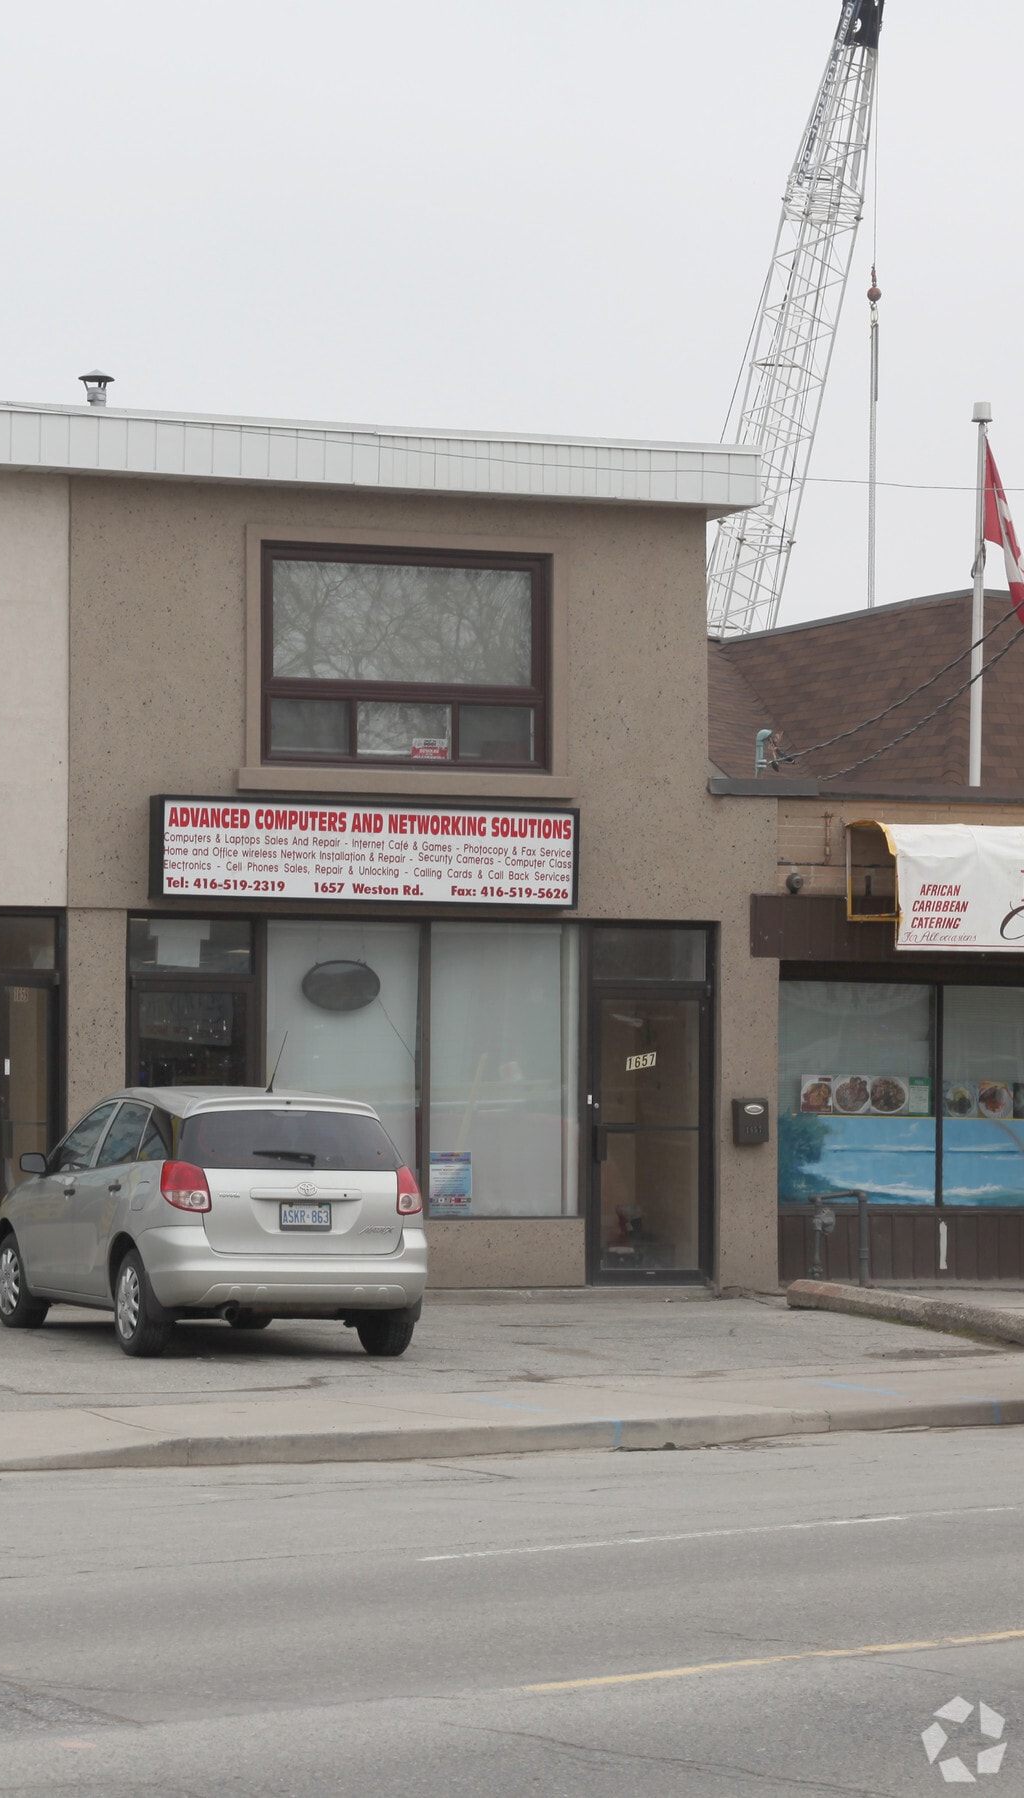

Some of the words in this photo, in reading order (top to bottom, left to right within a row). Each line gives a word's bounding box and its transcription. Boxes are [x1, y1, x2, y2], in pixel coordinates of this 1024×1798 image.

[168, 807, 250, 829] ADVANCED
[255, 808, 347, 833] COMPUTERS
[351, 812, 384, 834] AND
[388, 813, 487, 838] NETWORKING
[491, 816, 572, 840] SOLUTIONS
[164, 832, 212, 846] Computers
[215, 834, 221, 844] &
[224, 834, 261, 847] Laptops
[264, 835, 289, 846] Sales
[292, 836, 309, 847] And
[312, 837, 341, 849] Repair
[351, 838, 384, 850] Internet
[412, 841, 418, 851] &
[421, 842, 452, 853] Games
[463, 843, 509, 857] Photocopy
[512, 846, 517, 856] &
[521, 846, 536, 857] Fax
[540, 847, 572, 859] Service
[164, 846, 189, 856] Home
[192, 847, 209, 857] and
[212, 847, 239, 858] Office
[242, 847, 278, 859] wireless
[280, 849, 316, 861] Network
[319, 850, 366, 863] Installation
[369, 852, 375, 862] &
[378, 853, 406, 865] Repair
[418, 852, 453, 865] Security
[456, 854, 494, 866] Cameras
[504, 856, 546, 869] Computer
[548, 858, 572, 869] Class
[163, 859, 212, 871] Electronics
[225, 861, 243, 872] Cell
[247, 861, 279, 873] Phones
[283, 863, 310, 875] Sales,
[315, 864, 343, 876] Repair
[348, 865, 354, 875] &
[358, 865, 400, 879] Unlocking
[413, 867, 442, 880] Calling
[447, 868, 473, 880] Cards
[477, 870, 483, 880] &
[488, 869, 504, 881] Call
[508, 870, 530, 881] Back
[534, 871, 570, 883] Services
[166, 877, 189, 889] Tel:
[193, 878, 286, 892] 416-519-2319
[313, 882, 345, 894] 1657
[352, 883, 399, 896] Weston
[403, 884, 424, 896] Rd.
[451, 885, 476, 897] Fax:
[480, 886, 569, 899] 416-519-5626
[920, 884, 961, 897] AFRICAN
[912, 900, 968, 913] CARIBBEAN
[911, 917, 961, 929] CATERING
[628, 1053, 655, 1069] 1657
[282, 1209, 306, 1224] ASKR
[311, 1209, 329, 1224] 863
